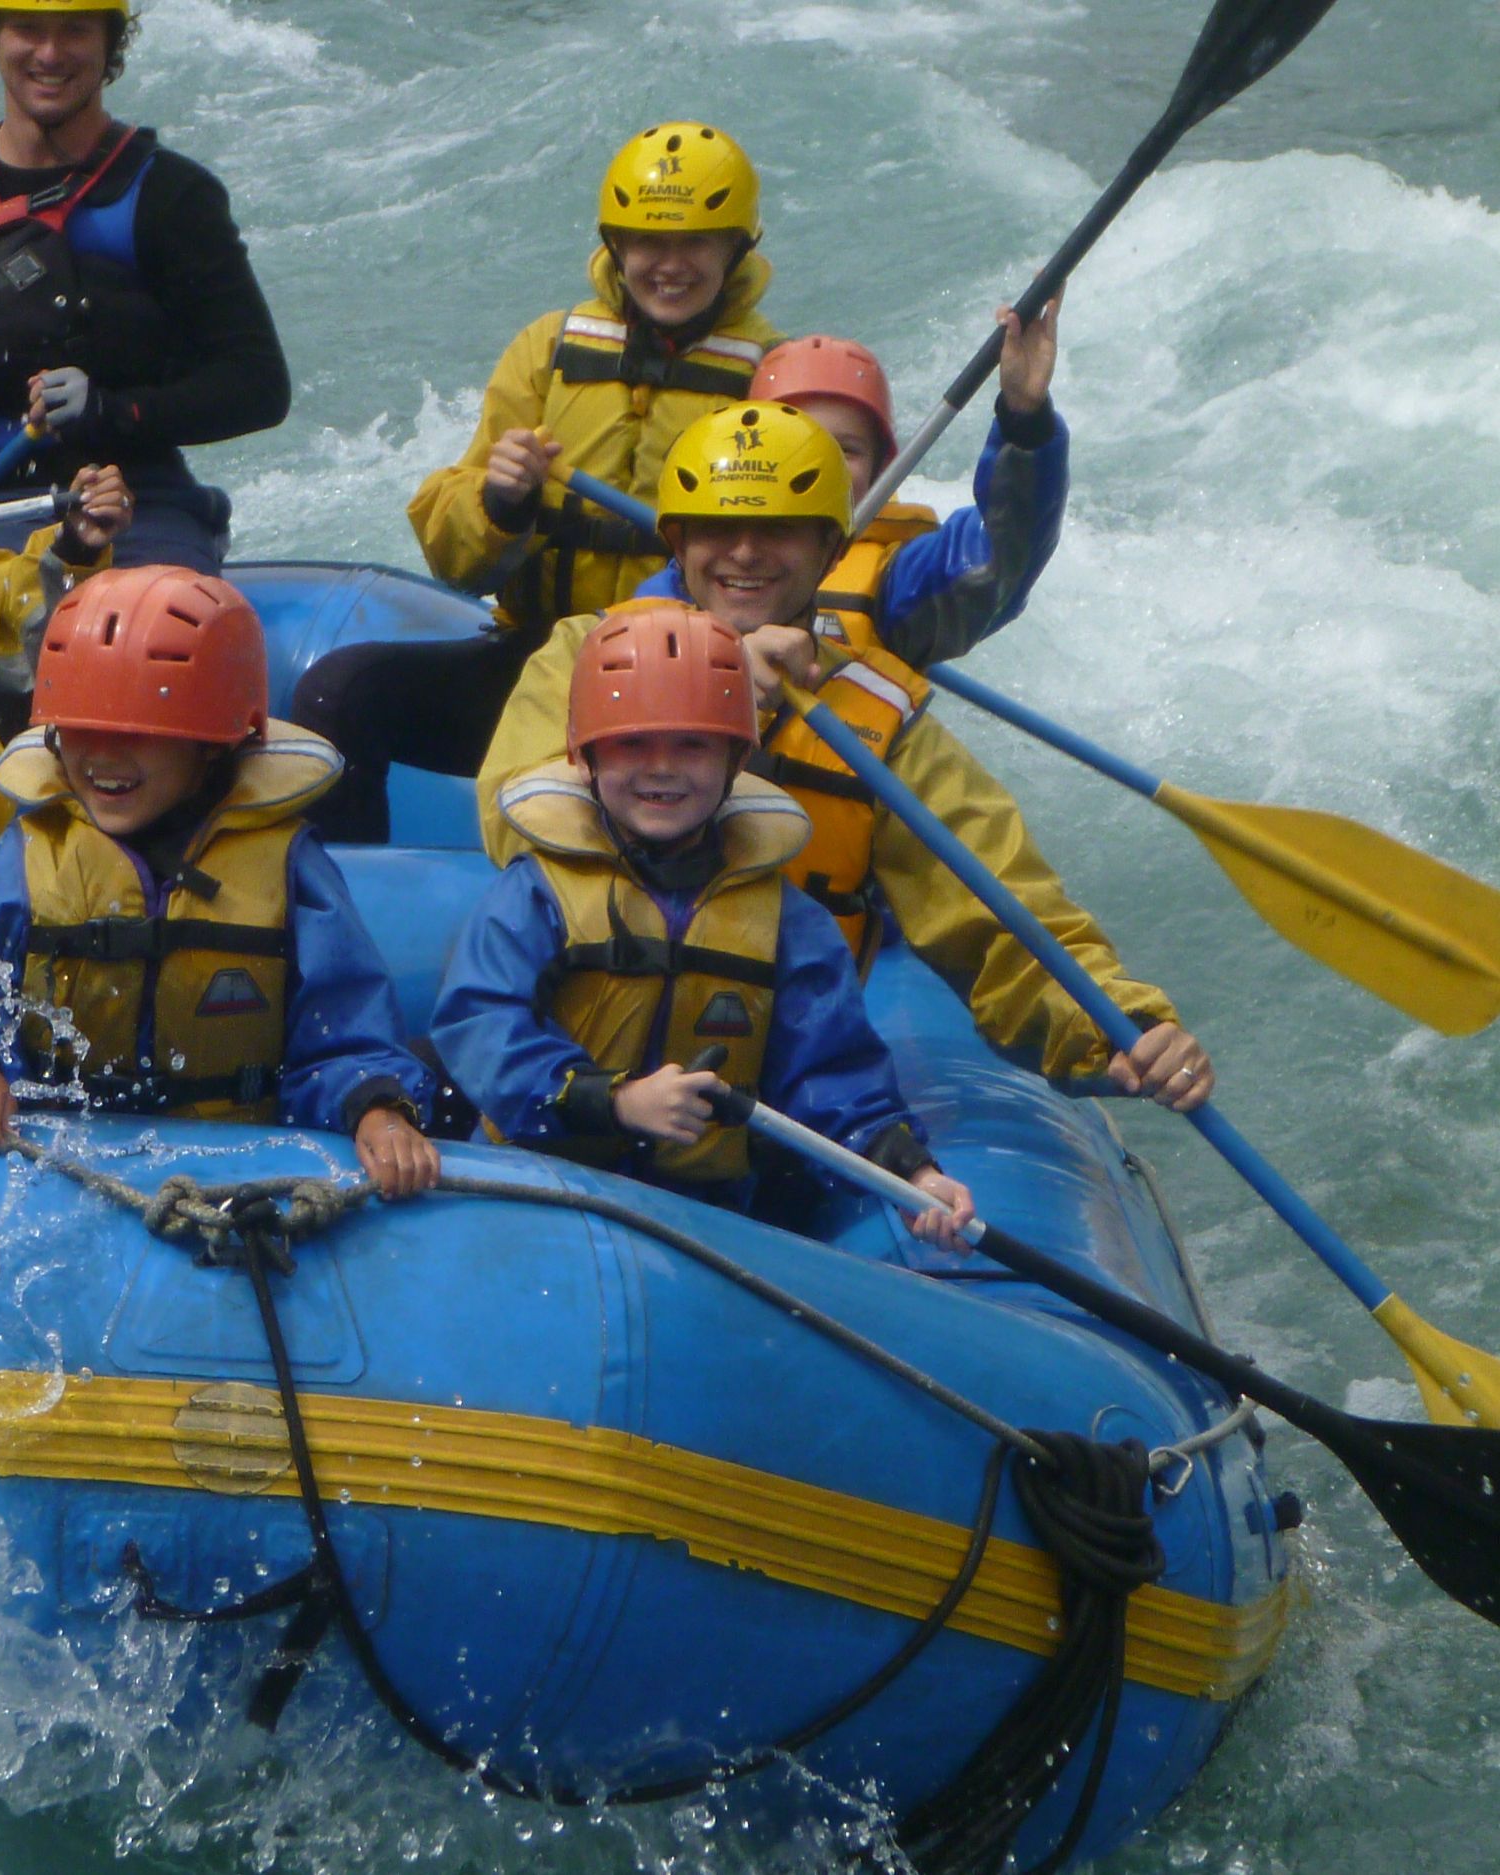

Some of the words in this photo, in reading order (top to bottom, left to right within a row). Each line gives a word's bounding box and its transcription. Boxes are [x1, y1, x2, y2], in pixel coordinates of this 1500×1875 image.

[638, 184, 695, 197] FAMILY
[646, 211, 685, 221] NRS
[709, 459, 779, 474] FAMILY
[709, 473, 778, 483] ADVENTURES
[719, 495, 767, 507] NRS
